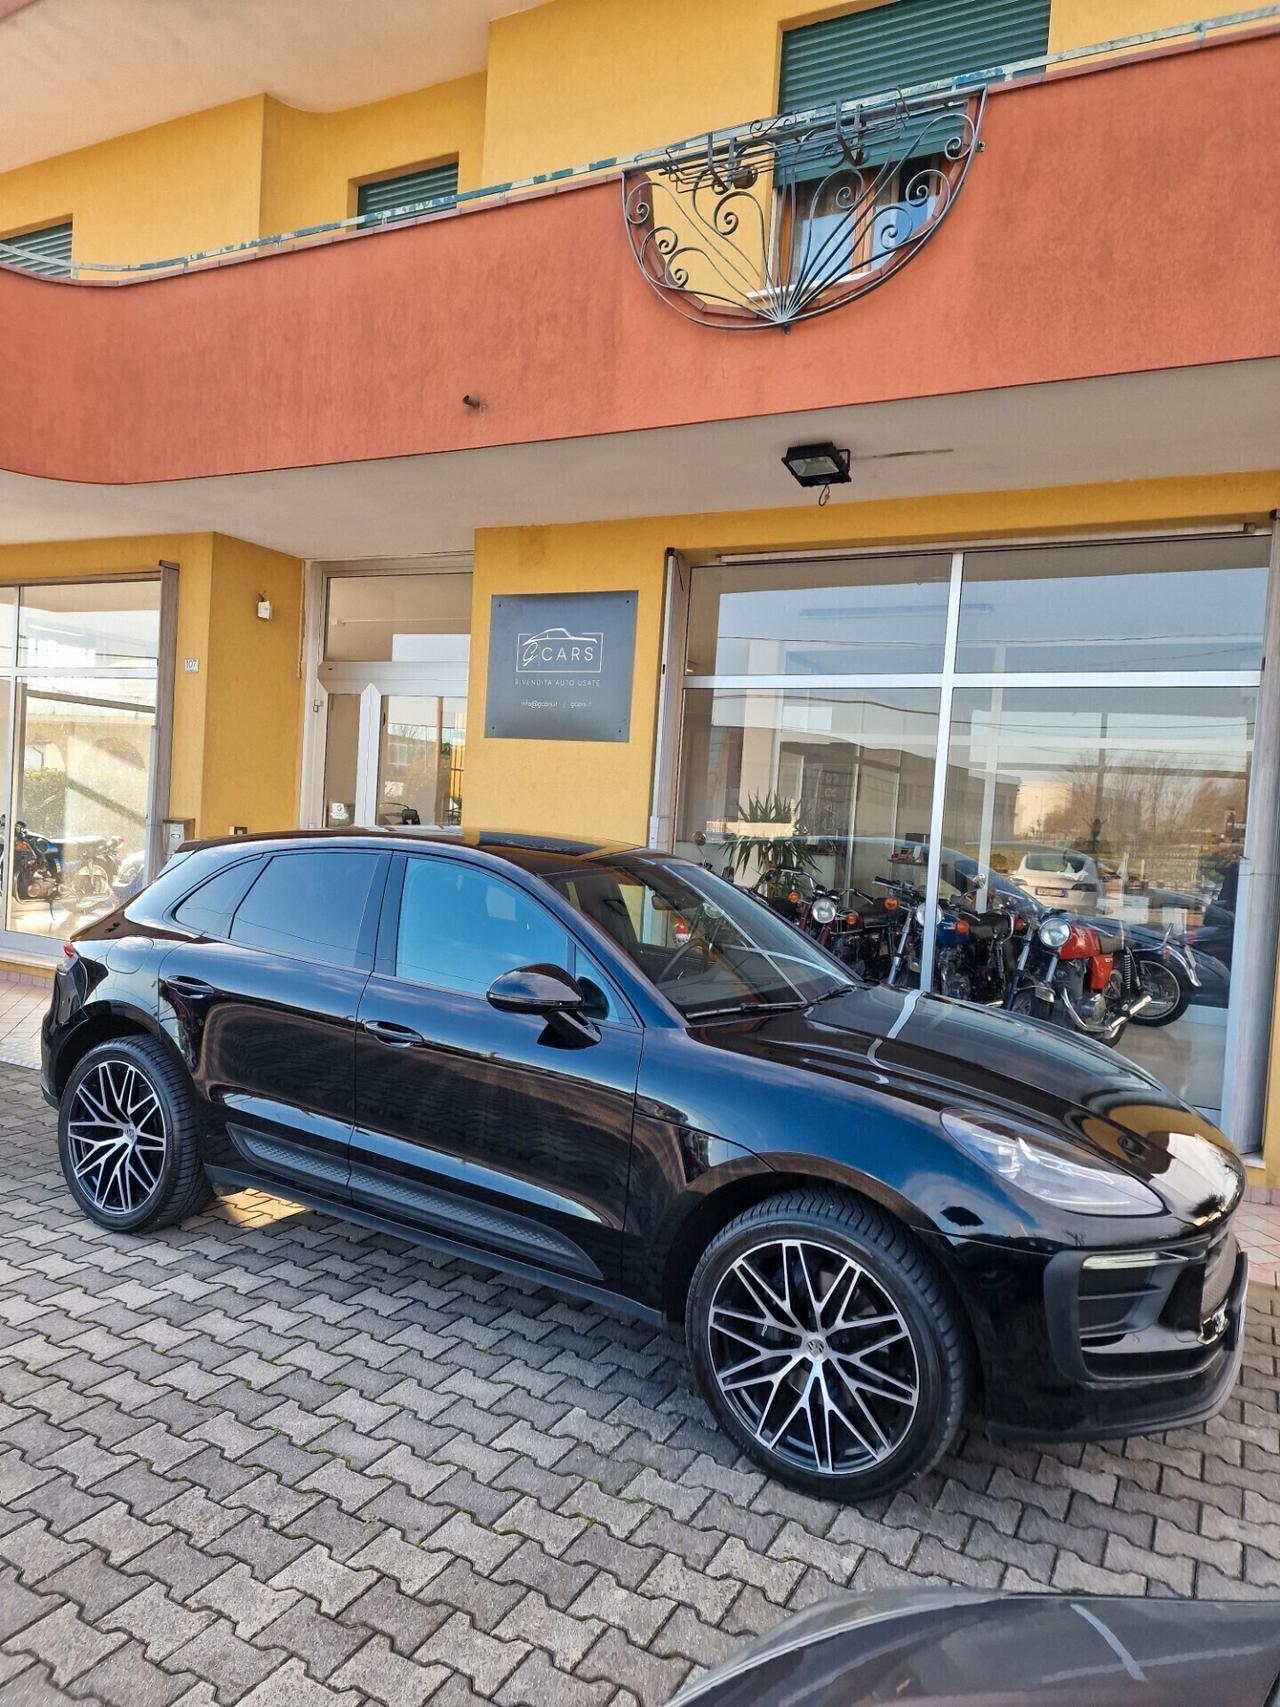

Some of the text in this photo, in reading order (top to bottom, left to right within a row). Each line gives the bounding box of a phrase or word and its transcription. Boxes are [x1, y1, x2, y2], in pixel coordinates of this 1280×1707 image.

[514, 679, 601, 687] RIVENDITA AUTO USATE
